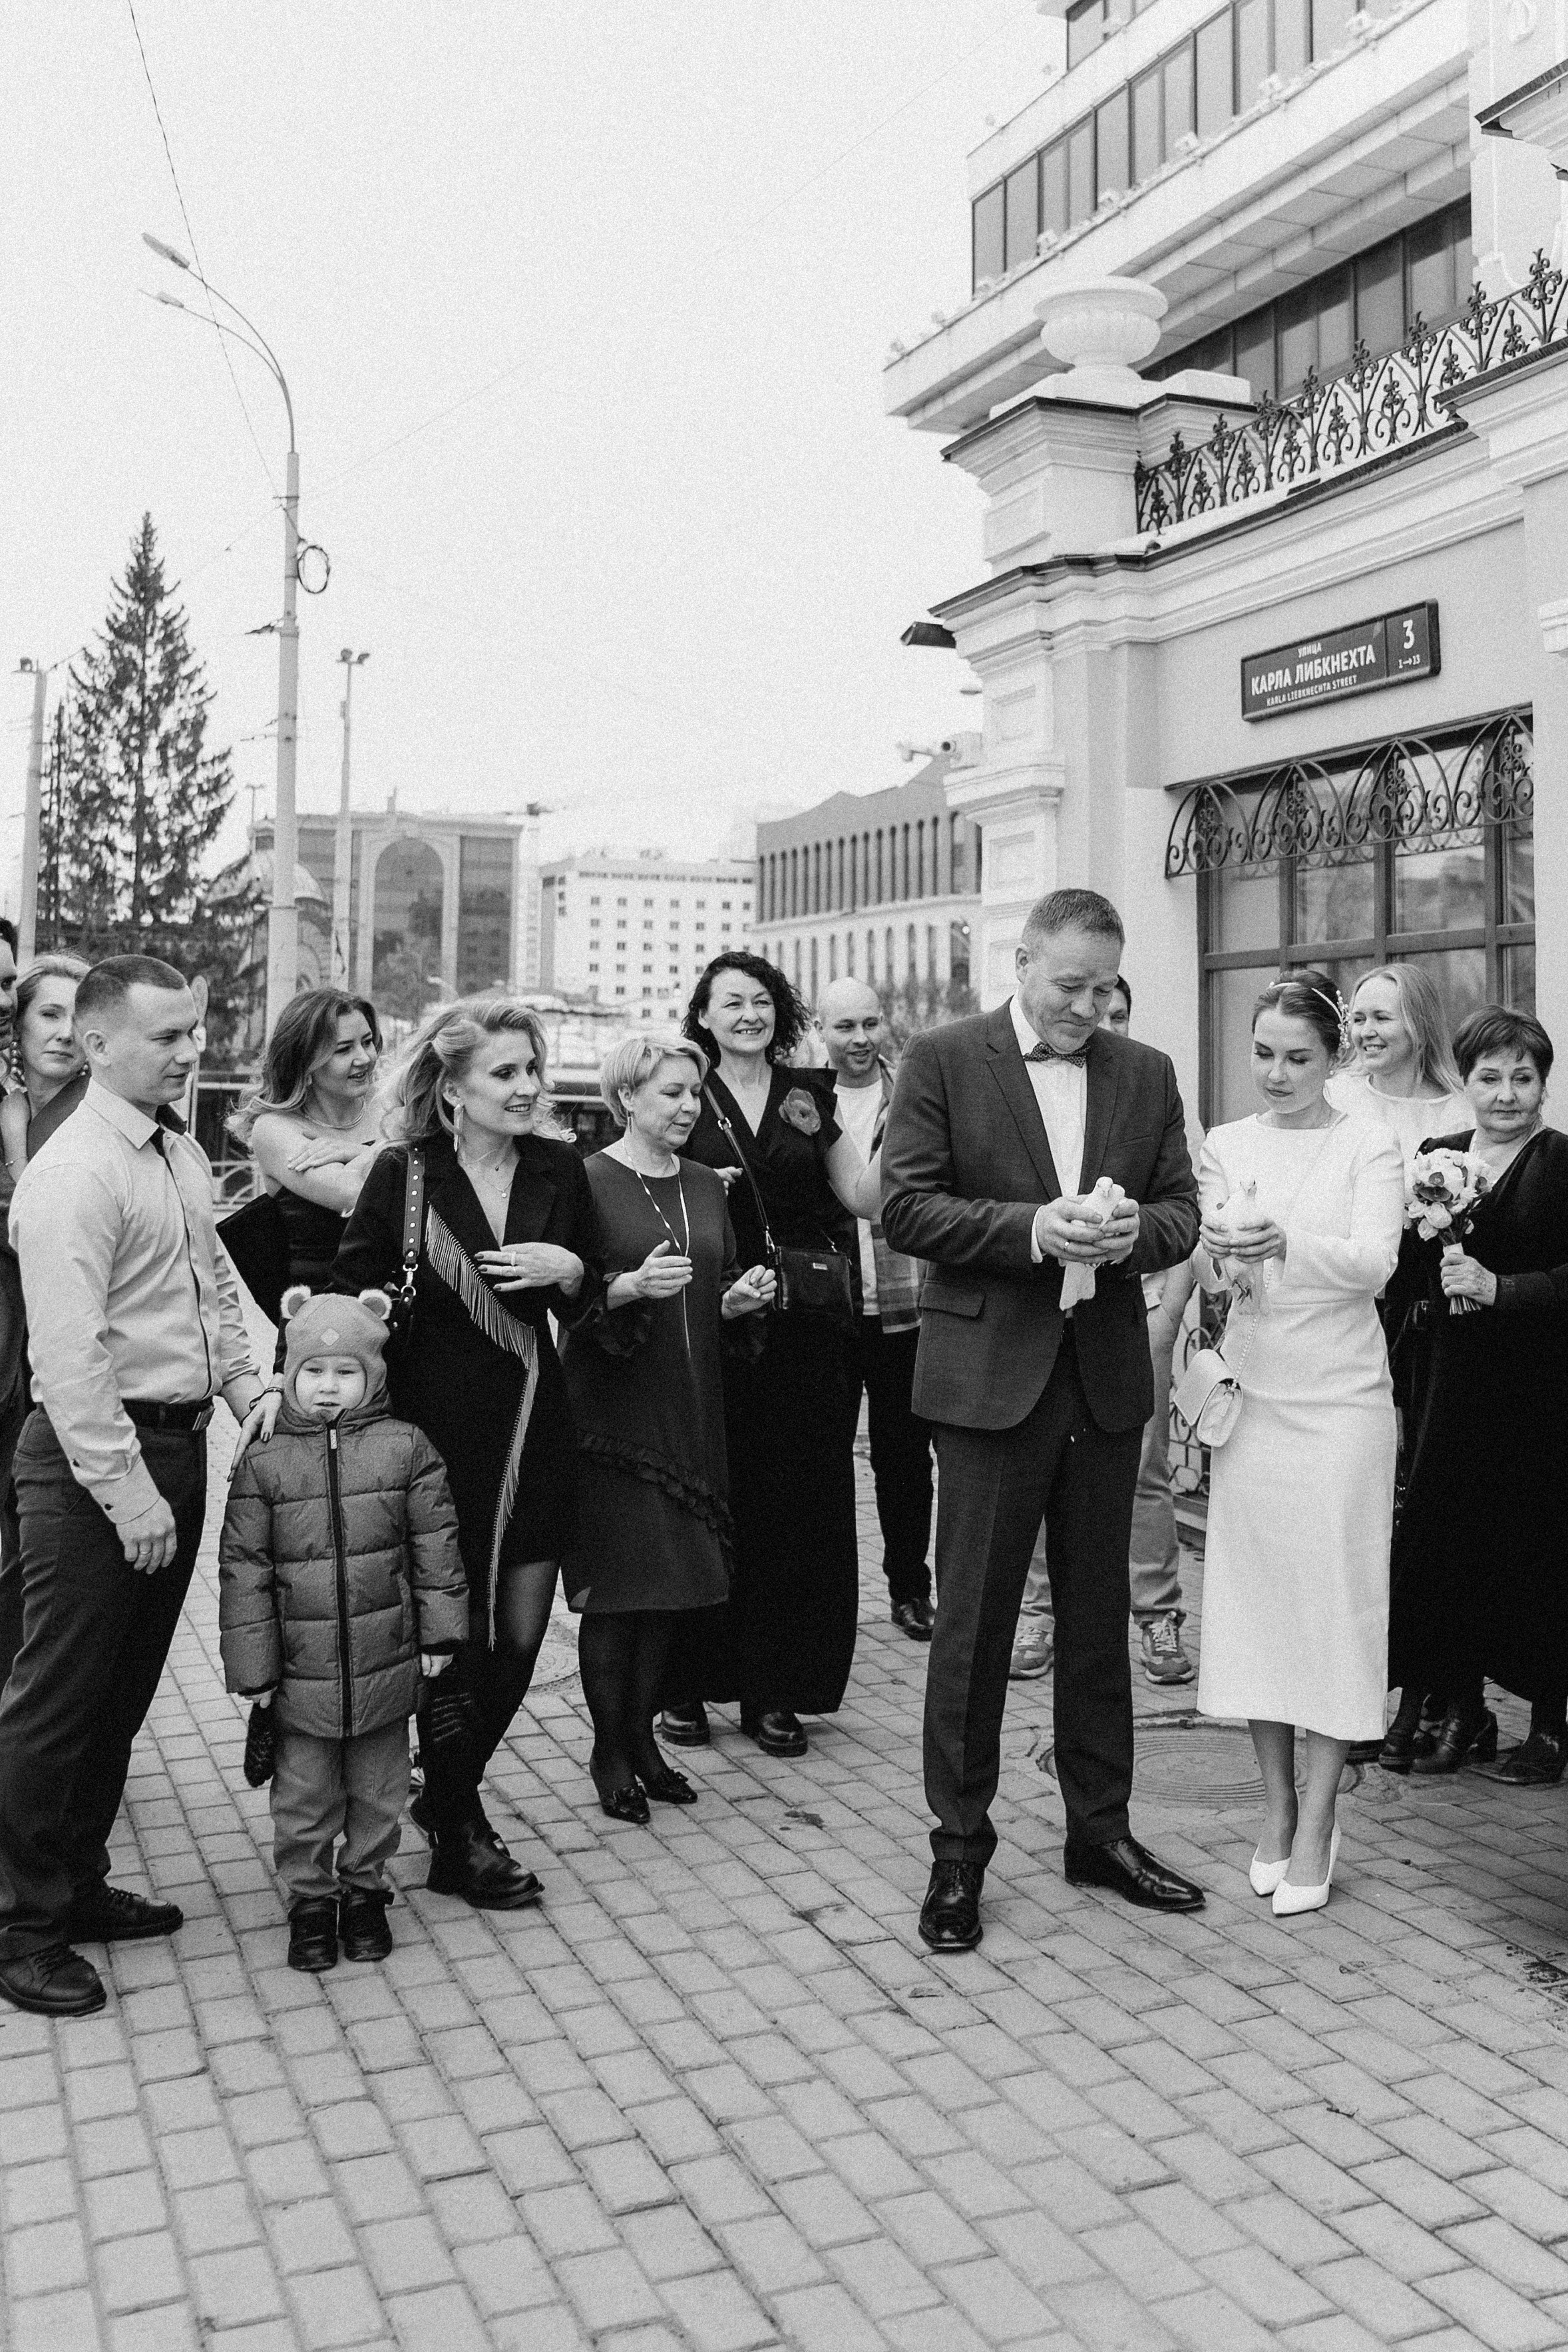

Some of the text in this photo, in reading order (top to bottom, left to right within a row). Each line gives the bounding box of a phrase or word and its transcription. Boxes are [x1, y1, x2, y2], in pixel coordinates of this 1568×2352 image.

[1297, 642, 1322, 658] УЛИЦА
[1402, 619, 1415, 650] 3
[1251, 644, 1376, 696] КАРЛА ЛИБКНЕХТА
[1267, 675, 1358, 706] KARLA LIEBKNECHTA STREET
